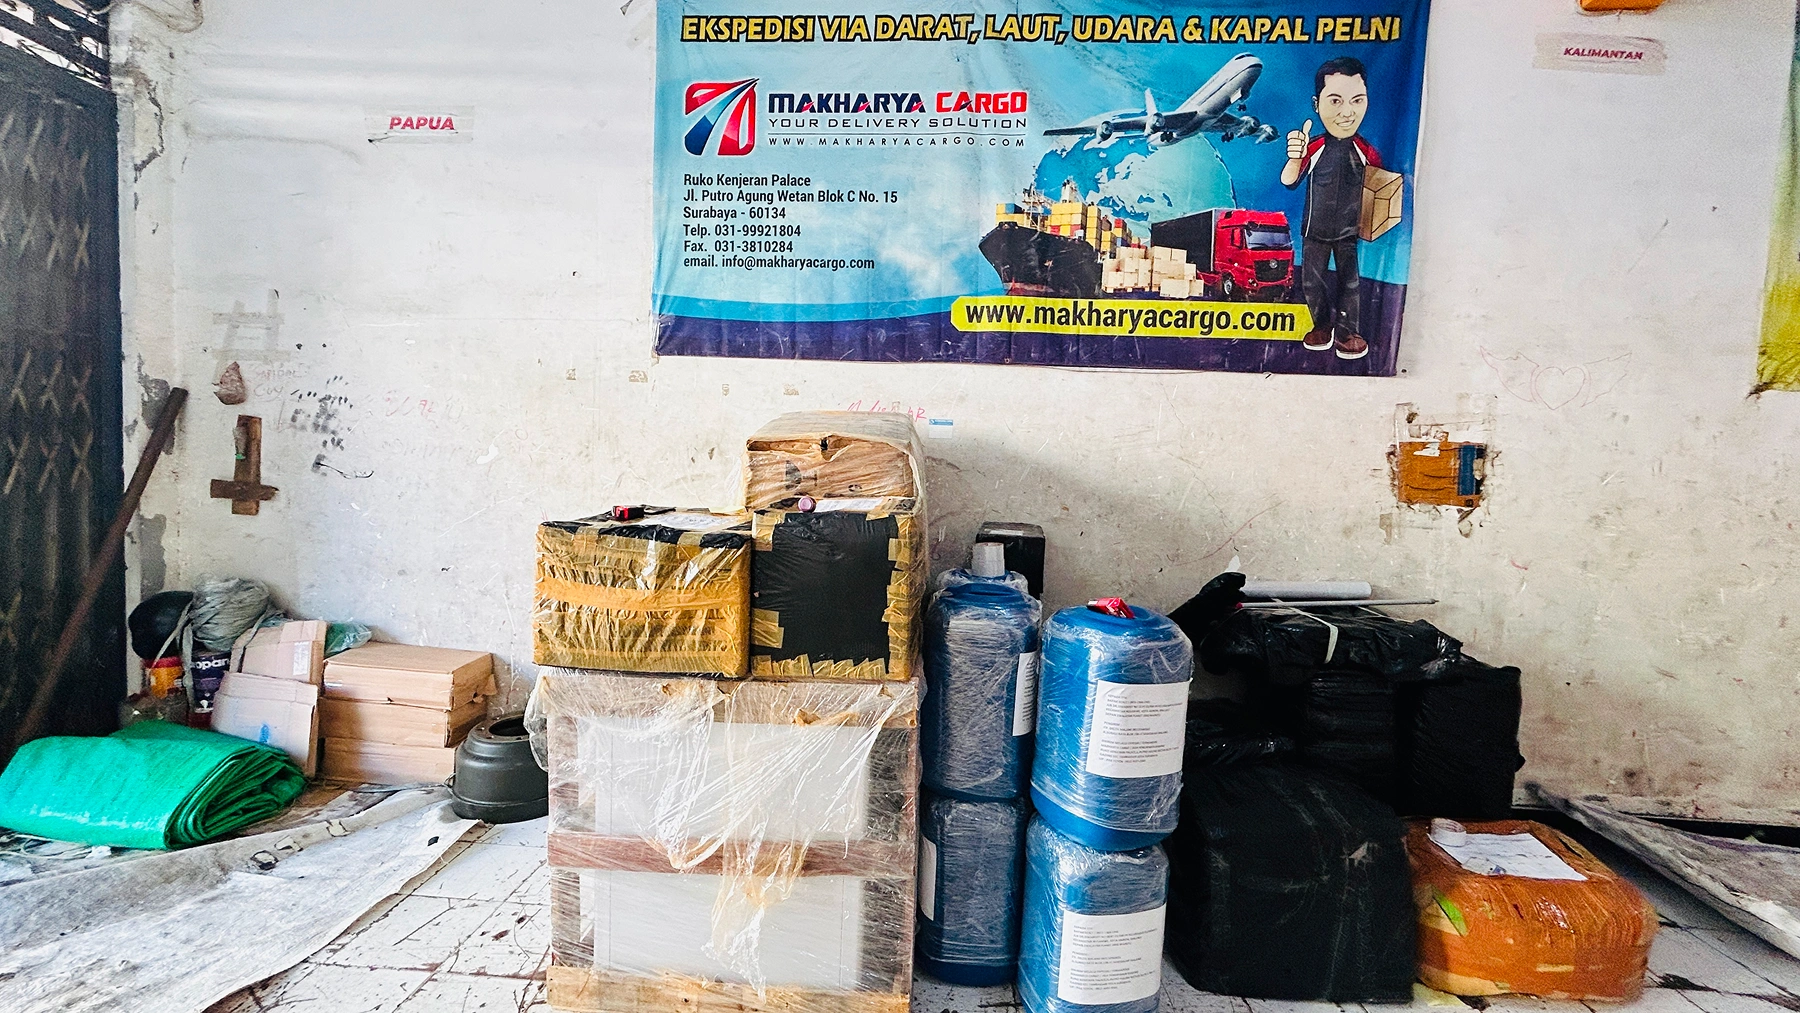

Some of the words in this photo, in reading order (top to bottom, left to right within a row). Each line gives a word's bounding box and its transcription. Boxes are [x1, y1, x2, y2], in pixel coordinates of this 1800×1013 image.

[680, 15, 816, 42] EKSPEDISI
[817, 15, 872, 42] VIA
[873, 13, 981, 45] DARAT,
[982, 13, 1069, 45] LAUT,
[1071, 15, 1179, 43] UDARA
[1181, 15, 1207, 43] &
[1208, 15, 1310, 43] KAPAL
[1314, 15, 1401, 43] PELNI
[1563, 47, 1644, 60] KALIMANTAN
[768, 93, 927, 114] MAKHARYA
[936, 91, 1028, 114] CARGO
[389, 116, 455, 130] PAPUA
[769, 118, 819, 128] YOUR
[828, 118, 921, 128] DELIVERY
[928, 117, 1027, 129] SOLUTION
[683, 173, 714, 186] Ruko
[717, 173, 768, 189] Kenjeran
[771, 174, 811, 187] Palace
[683, 188, 698, 202] Jl.
[702, 190, 733, 202] Putro
[737, 190, 774, 205] Agung
[777, 190, 814, 202] Wetan
[818, 190, 845, 202] Blok
[847, 190, 856, 202] C
[859, 190, 879, 203] No.
[883, 191, 898, 203] 15
[683, 206, 737, 221] Surabaya
[749, 207, 786, 219] 60134
[683, 224, 711, 238] Telp.
[715, 224, 801, 237] 031-99921804
[684, 240, 707, 253] Fax.
[714, 240, 793, 253] 031-3810284
[683, 255, 718, 267] email.
[722, 255, 875, 272] info@makharyacargo.com
[965, 301, 1296, 335] www.makharyacargo.com
